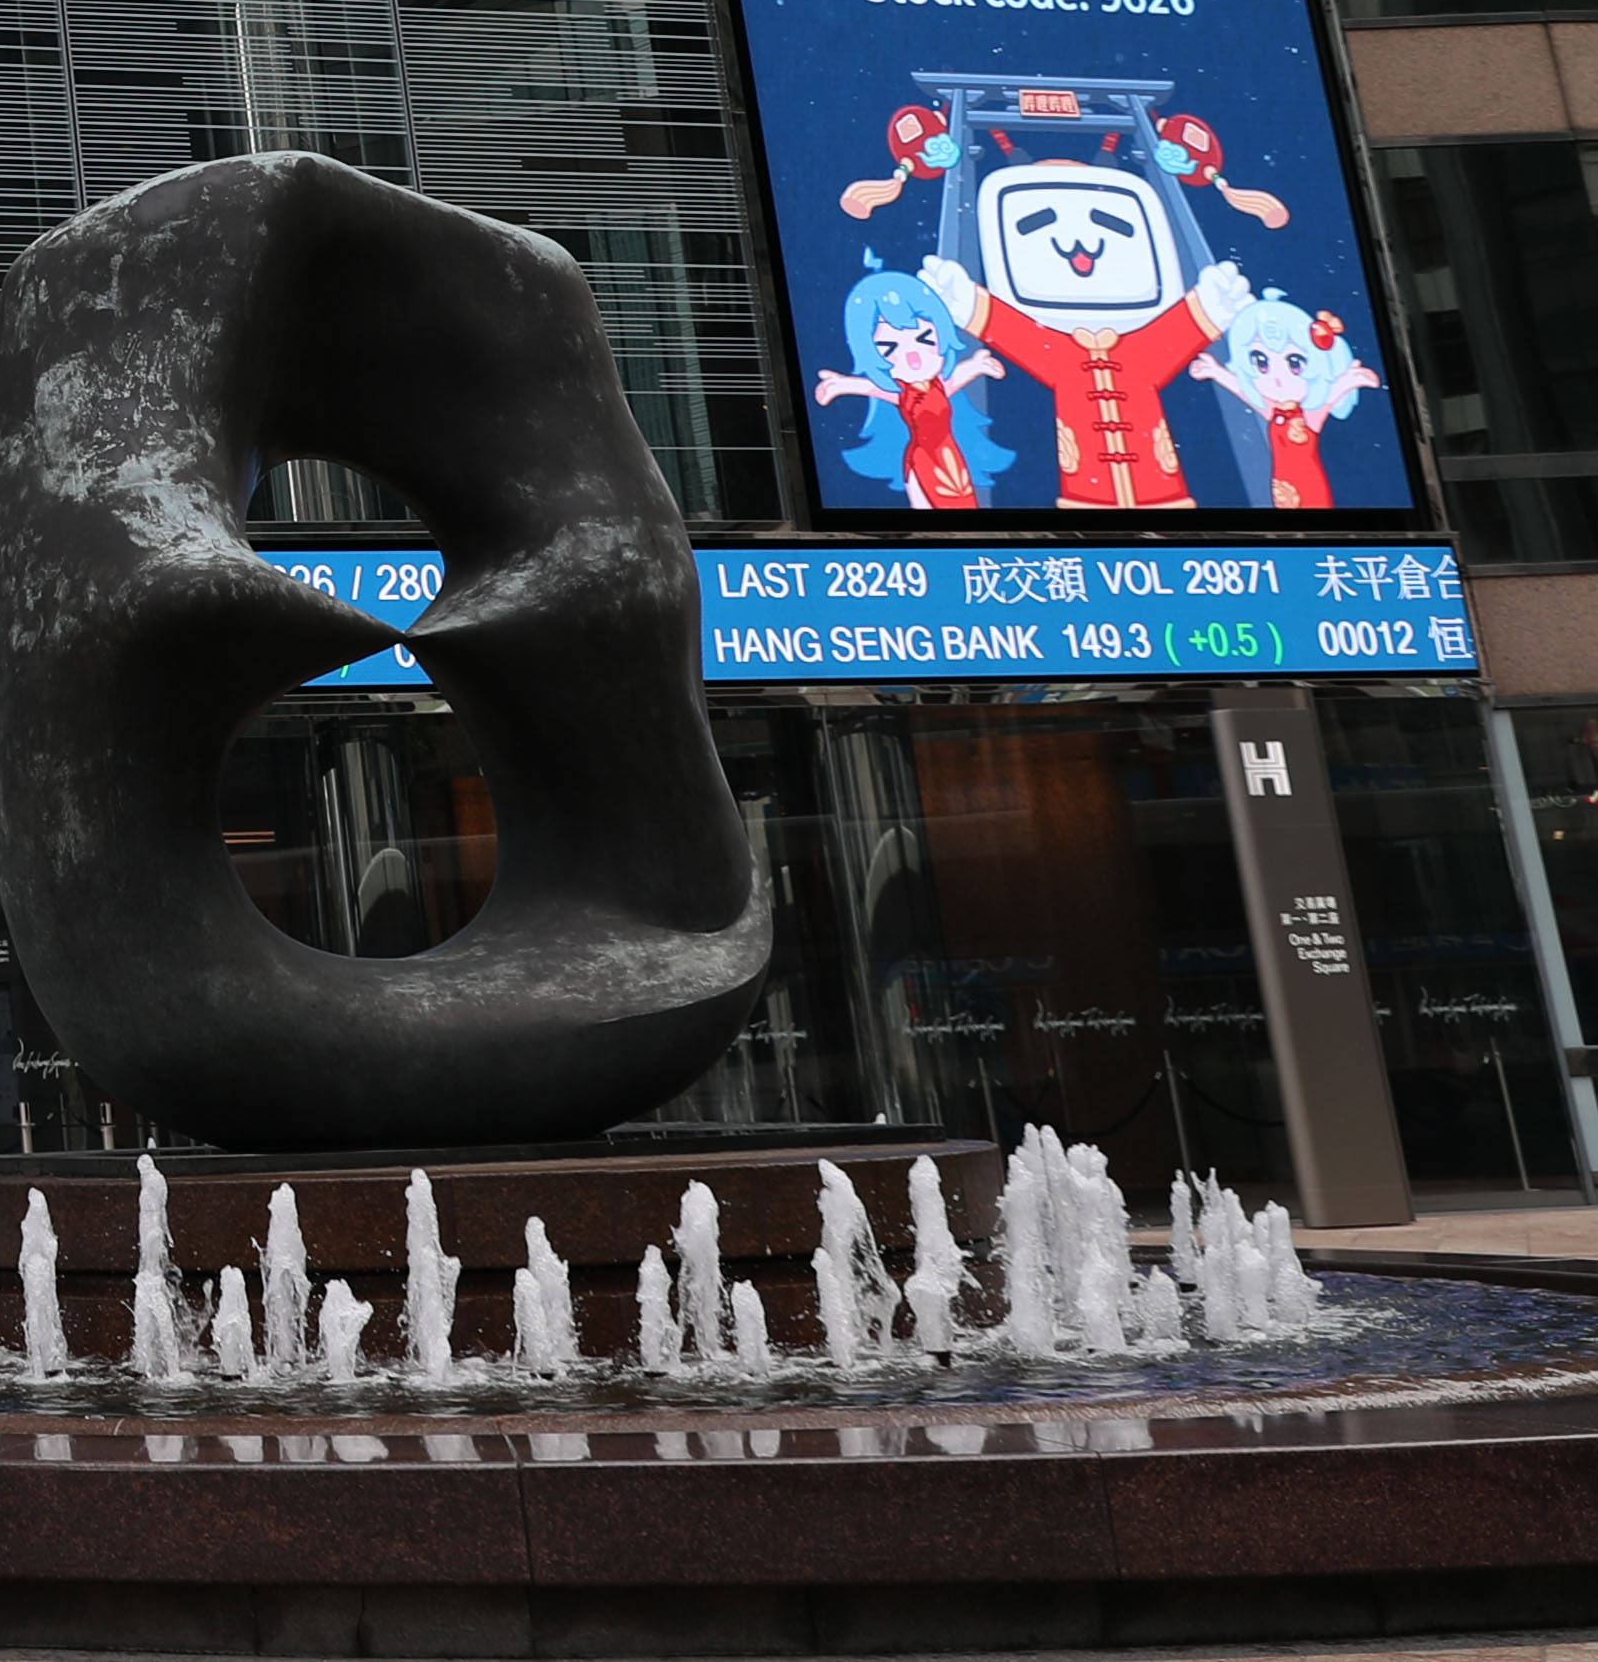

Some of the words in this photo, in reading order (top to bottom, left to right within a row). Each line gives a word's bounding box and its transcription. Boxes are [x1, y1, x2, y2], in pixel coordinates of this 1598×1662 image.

[718, 563, 809, 598] LAST
[825, 562, 927, 597] 28249
[963, 557, 1088, 603] 成交額
[1097, 561, 1173, 595] VOL
[1183, 561, 1279, 594] 29871
[715, 627, 823, 662] HANG
[831, 626, 935, 662] SENG
[942, 626, 1044, 659] BANK
[1063, 623, 1151, 658] 149.3
[1319, 621, 1417, 656] 00012
[1428, 617, 1474, 661] 恒
